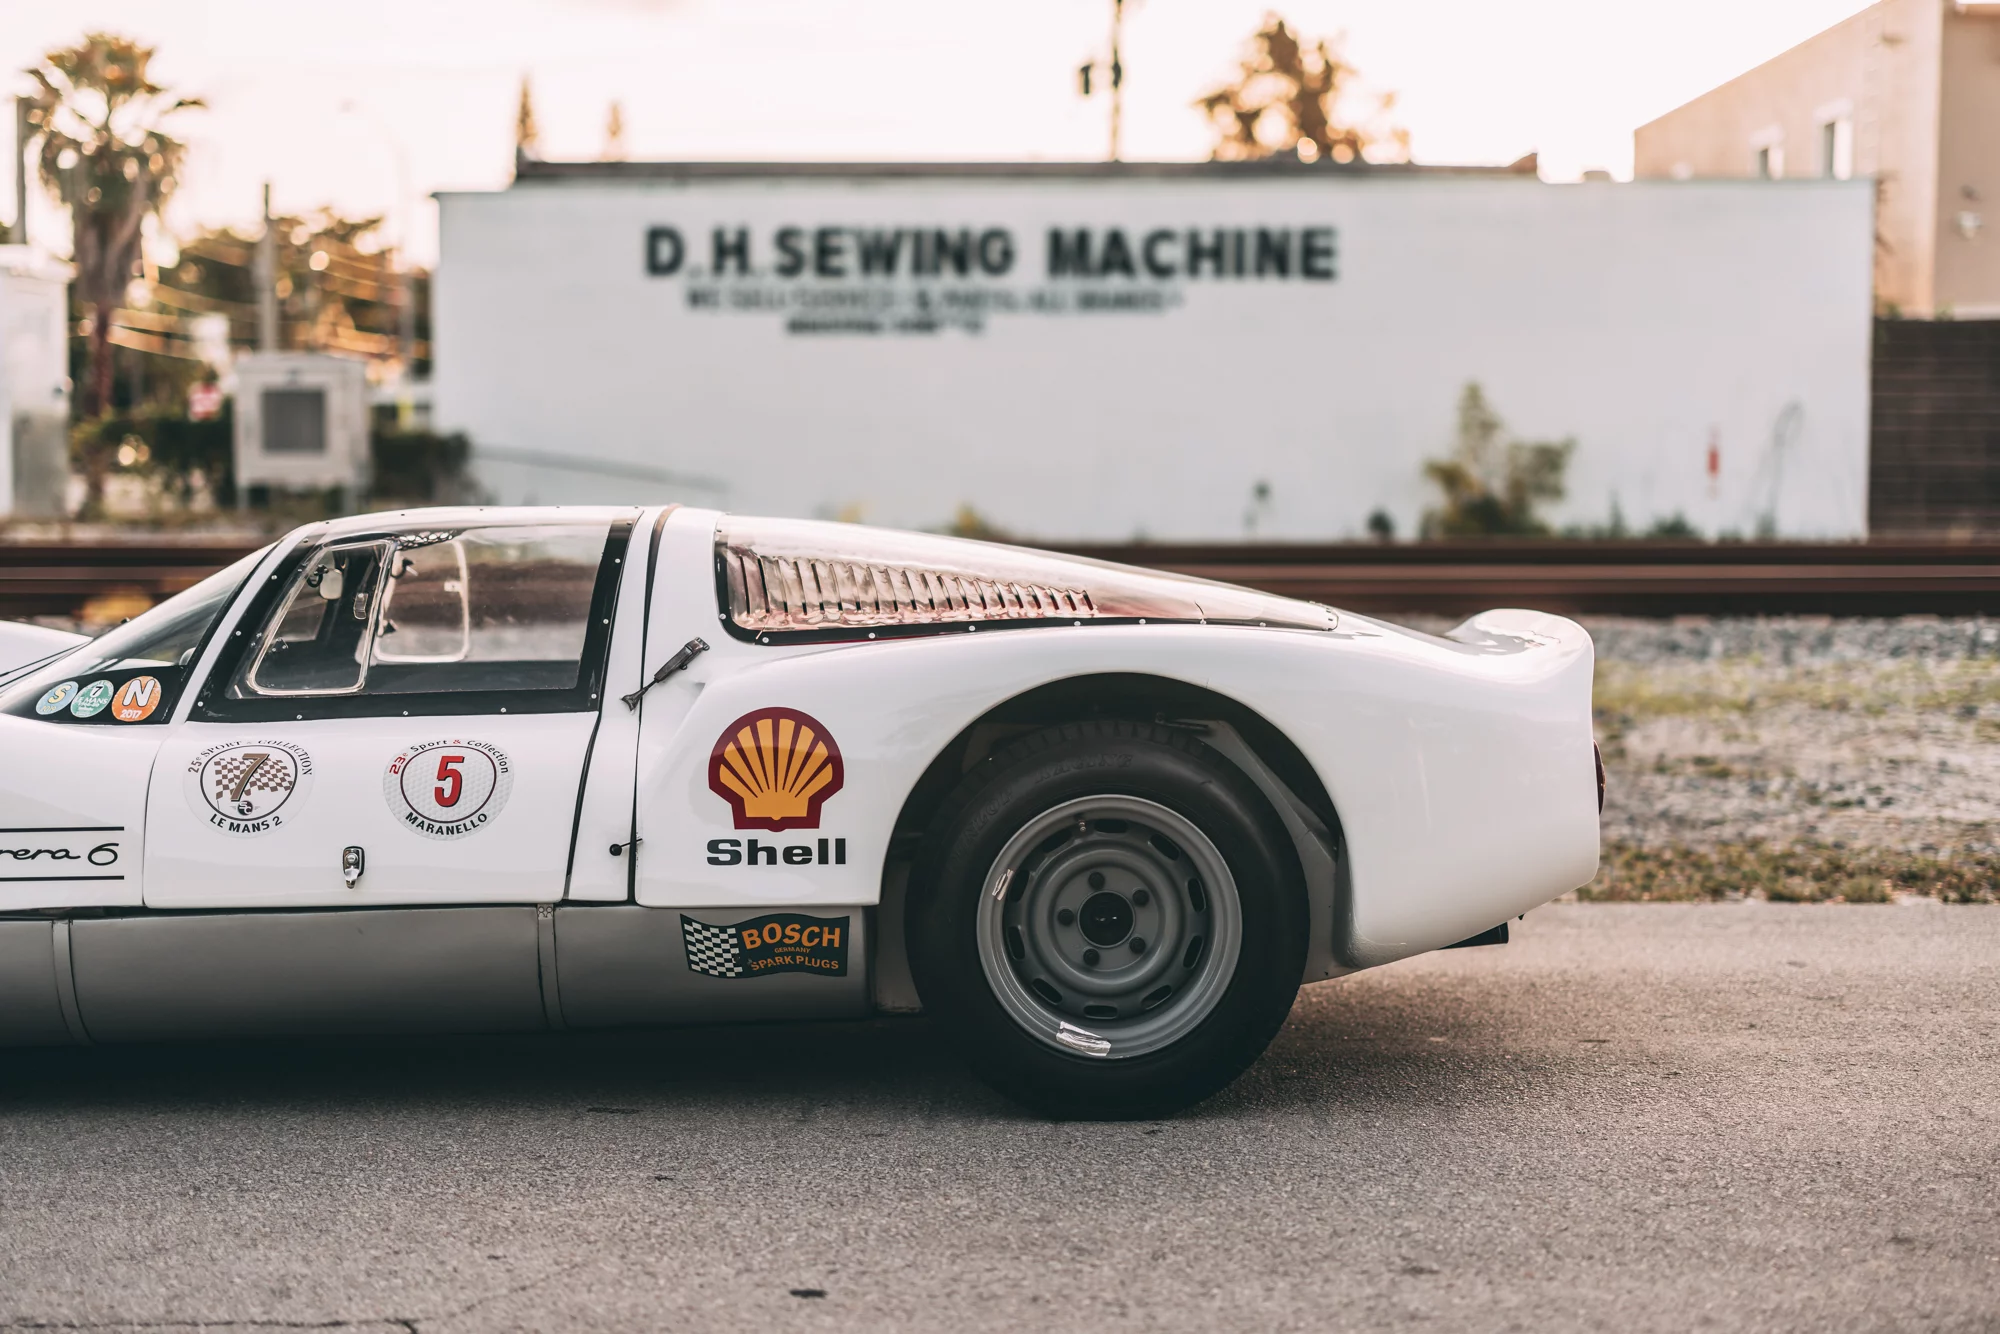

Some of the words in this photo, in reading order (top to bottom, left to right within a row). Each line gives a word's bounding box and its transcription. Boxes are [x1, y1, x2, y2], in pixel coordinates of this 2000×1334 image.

[1046, 226, 1340, 281] MACHINE
[47, 684, 72, 704] S
[93, 685, 104, 696] 7
[122, 679, 156, 707] N
[119, 709, 143, 719] 2017
[200, 741, 241, 757] SPORT
[257, 740, 312, 775] COLLECTION
[410, 740, 447, 752] Sport
[467, 740, 509, 774] Collection
[231, 753, 271, 802] 7
[434, 755, 466, 808] 5
[209, 813, 227, 828] LE
[228, 820, 270, 833] MANS
[272, 815, 283, 826] 2
[405, 811, 488, 836] MARANELLO
[87, 842, 119, 866] 6
[706, 837, 847, 866] Shell
[741, 922, 841, 950] BOSCH
[750, 955, 795, 971] SPARK
[796, 955, 839, 970] PLUGS
[774, 946, 811, 954] GERMANY
